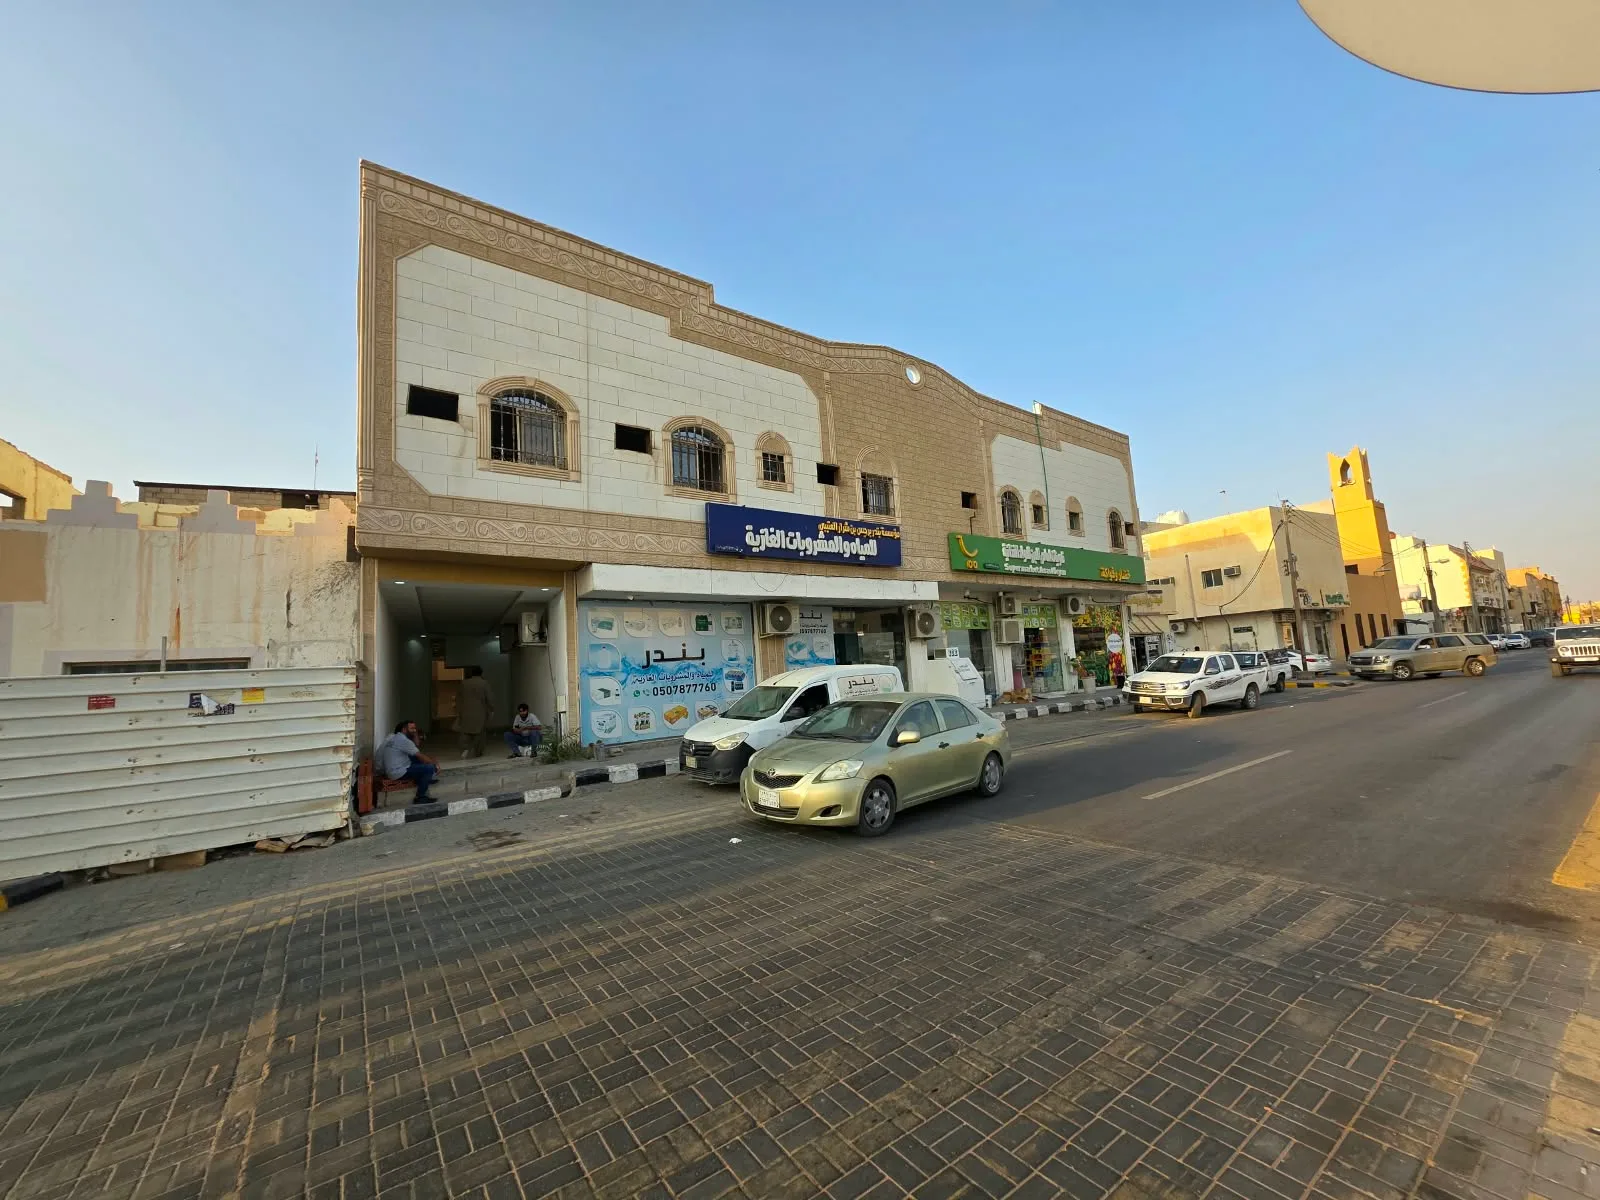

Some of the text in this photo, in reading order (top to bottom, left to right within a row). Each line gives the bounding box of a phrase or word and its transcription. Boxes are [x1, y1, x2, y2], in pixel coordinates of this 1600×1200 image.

[745, 524, 787, 553] الغازية
[882, 527, 900, 539] مؤسسة
[850, 536, 878, 560] للمياه
[800, 610, 823, 622] بند
[642, 642, 706, 670] بندر
[652, 682, 717, 697] 0507877760
[848, 677, 876, 690] بندر
